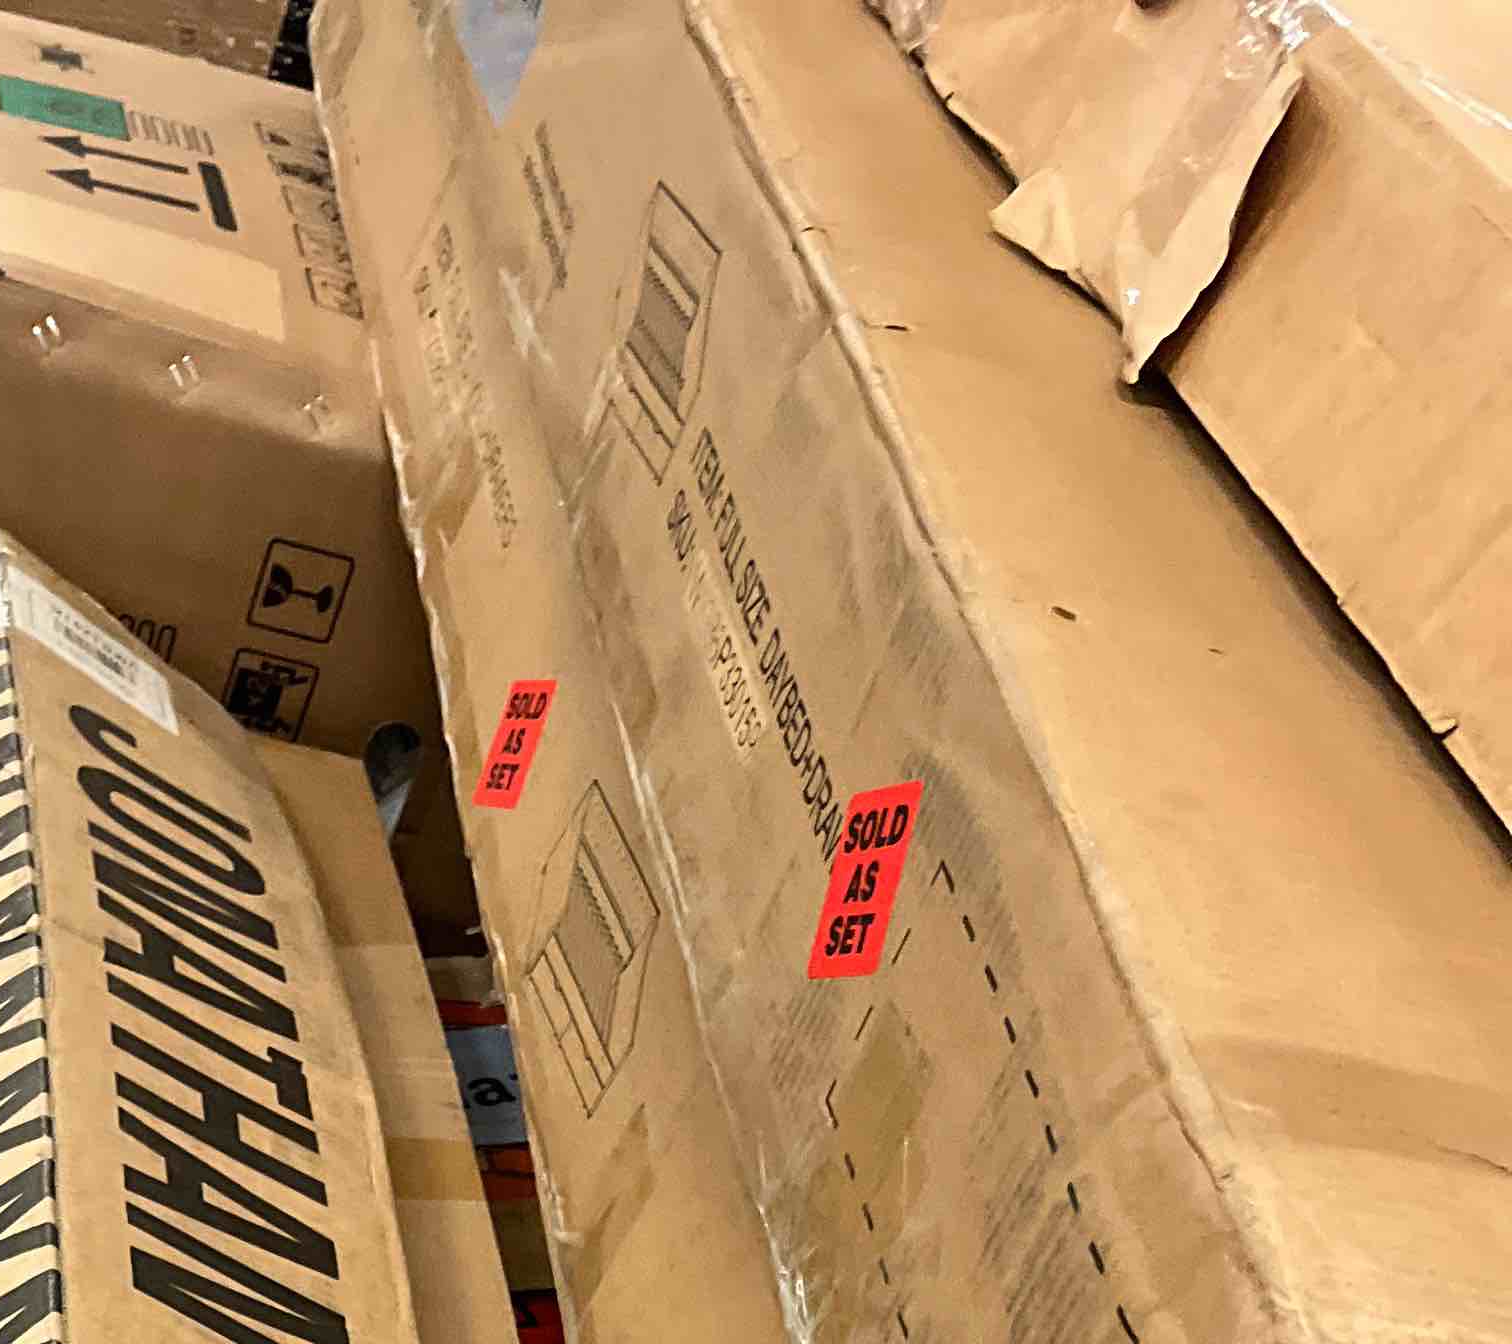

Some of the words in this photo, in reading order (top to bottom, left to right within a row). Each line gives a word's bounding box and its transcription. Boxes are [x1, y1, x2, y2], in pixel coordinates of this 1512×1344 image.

[713, 492, 748, 586] FULL
[735, 558, 772, 646] SIZE
[505, 693, 549, 720] SOLD
[503, 728, 527, 755] AS
[485, 763, 521, 791] SET
[843, 804, 909, 854] SOLD
[843, 862, 880, 904] AS
[824, 914, 874, 958] SET
